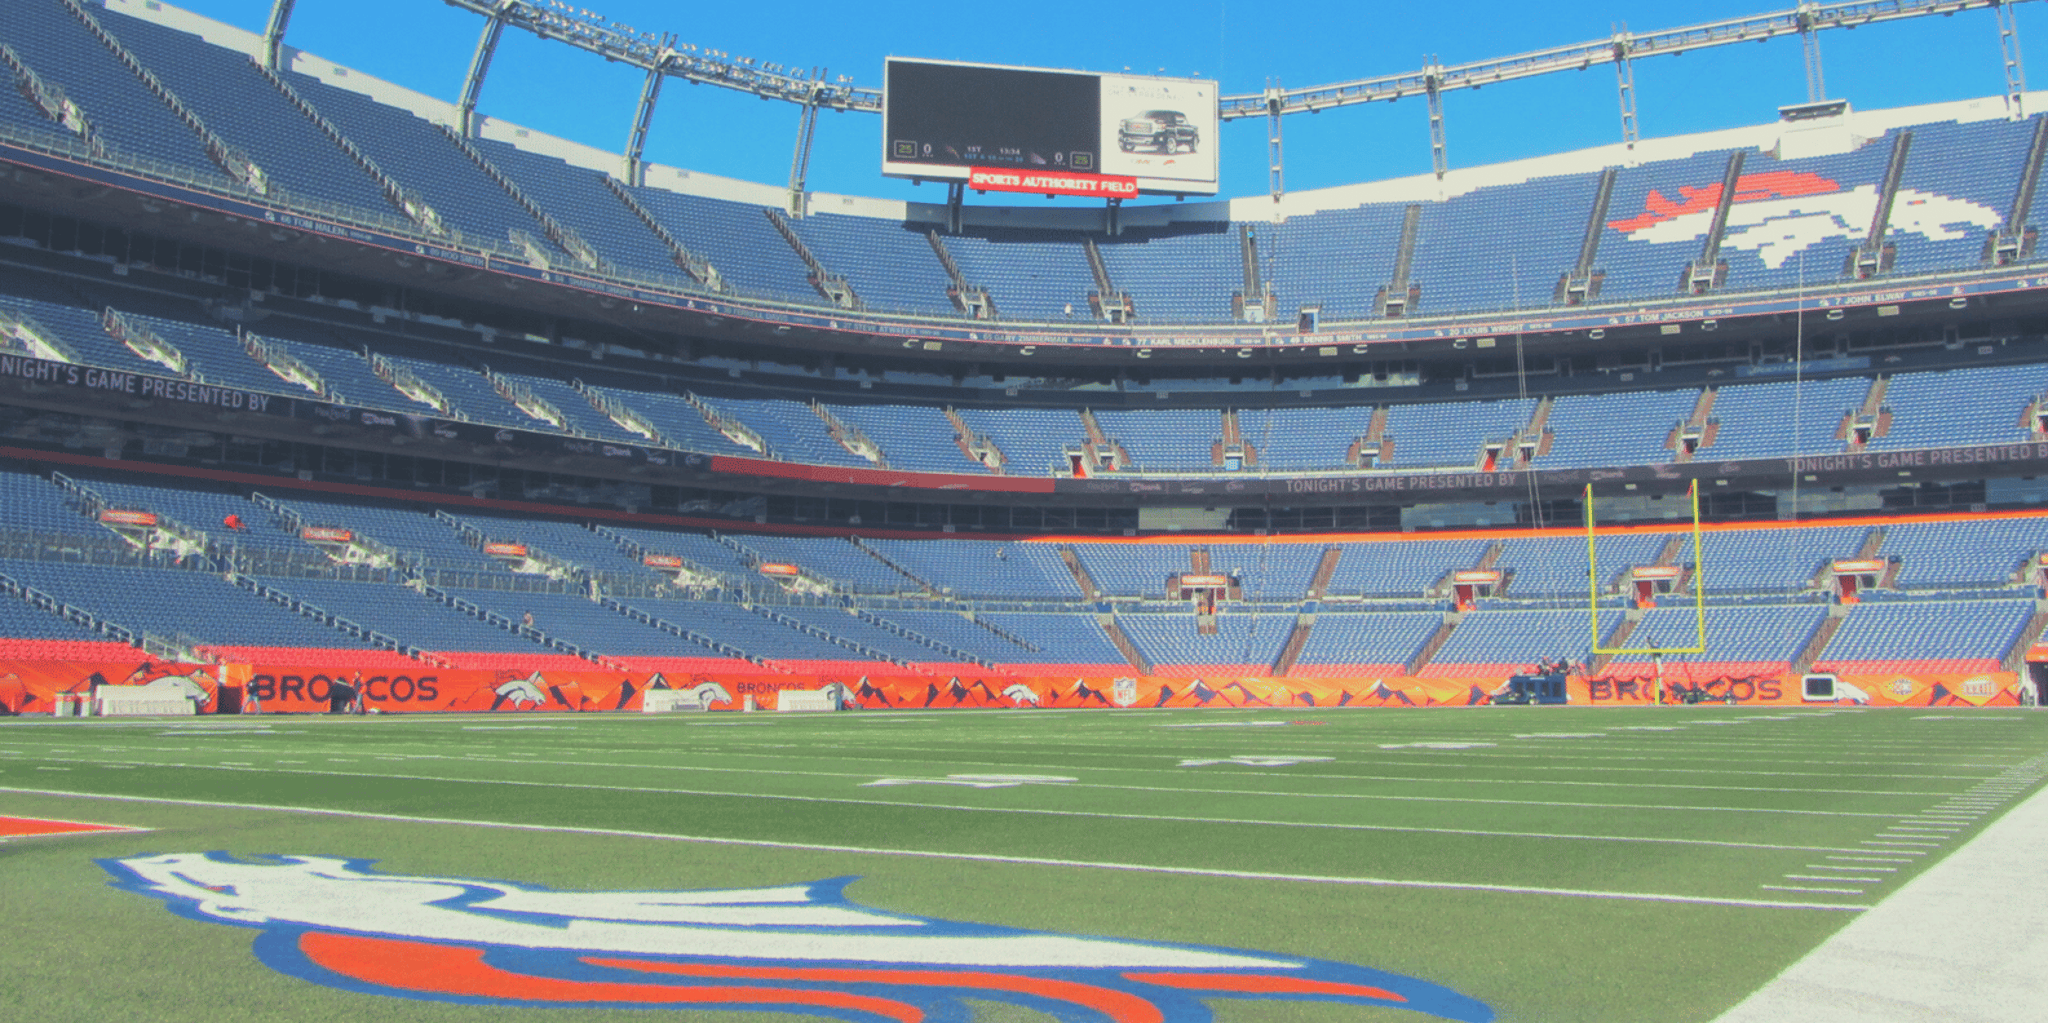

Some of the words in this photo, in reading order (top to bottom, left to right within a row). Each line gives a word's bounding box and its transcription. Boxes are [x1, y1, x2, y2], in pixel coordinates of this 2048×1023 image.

[898, 144, 912, 153] 25
[923, 143, 932, 154] 0
[1055, 152, 1063, 162] 0
[972, 173, 1020, 185] SPORTS
[1022, 176, 1098, 190] AUTHORITY
[1101, 181, 1135, 192] FIELD
[294, 217, 313, 229] TOM
[441, 250, 459, 260] ROD
[460, 253, 483, 266] SMITH
[1844, 296, 1871, 304] JOHN
[1875, 292, 1905, 301] ELWAY
[1661, 310, 1704, 320] JACKSON
[854, 323, 876, 332] STEVE
[878, 326, 916, 334] ATWATER
[1491, 324, 1524, 332] WRIGHT
[1019, 335, 1068, 343] ZIMMERMAN
[0, 355, 78, 385] NIGHT'S
[85, 369, 136, 393] GAME
[142, 378, 242, 408] PRESENTED
[249, 394, 269, 412] BY
[1786, 455, 1872, 473] TONIGHT'S
[1878, 452, 1925, 468] GAME
[1931, 445, 2030, 464] PRESENTED
[1286, 479, 1361, 492] TONIGHT'S
[1365, 477, 1405, 490] GAME
[1410, 474, 1493, 489] PRESENTED
[1499, 473, 1517, 486] BY
